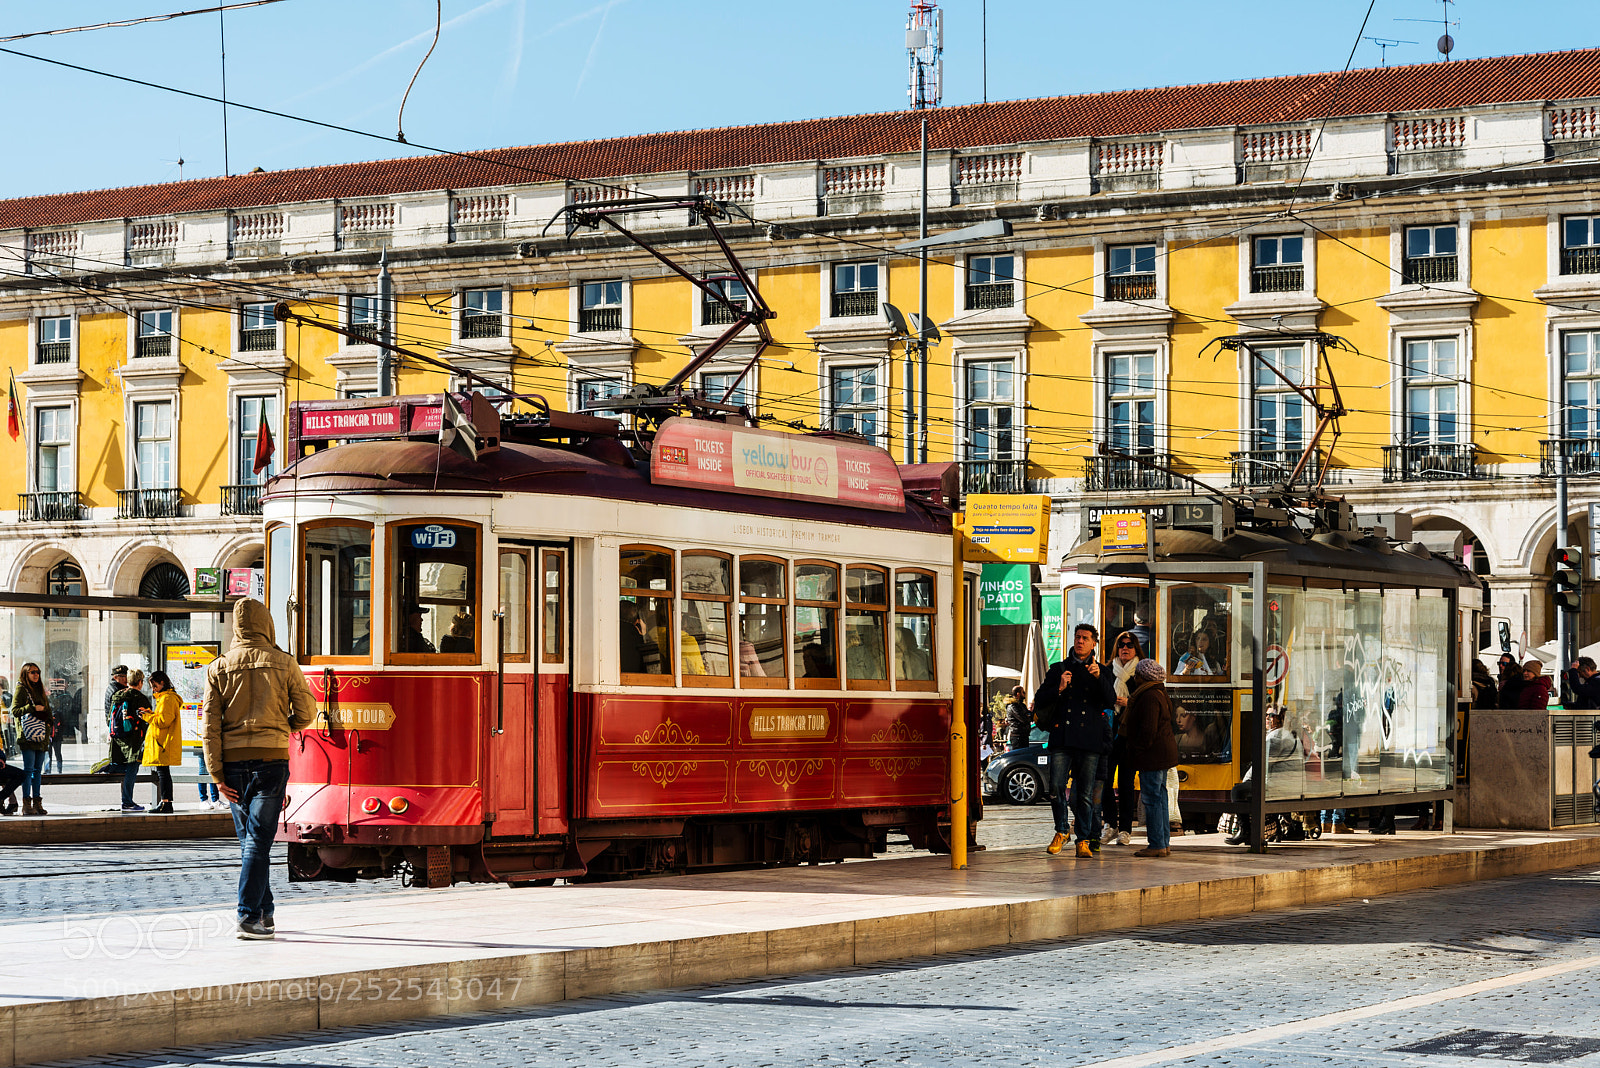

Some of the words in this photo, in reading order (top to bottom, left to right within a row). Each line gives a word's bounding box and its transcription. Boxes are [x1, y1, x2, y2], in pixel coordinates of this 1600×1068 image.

[306, 415, 331, 429] HILLS
[333, 413, 370, 428] TRAMCAR
[371, 412, 394, 426] TOUR
[694, 438, 724, 454] TICKETS
[698, 457, 722, 472] INSIDE
[845, 459, 871, 474] TICKETS
[745, 469, 766, 479] OFFICIAL
[767, 471, 796, 483] SIGHTSEEING
[797, 475, 812, 485] TOURS
[847, 476, 869, 490] INSIDE
[1184, 505, 1204, 520] 15
[733, 524, 753, 535] LISBON
[757, 527, 788, 539] HISTORICAL
[792, 530, 815, 541] PREMIUM
[818, 532, 840, 543] TRAMCAR
[980, 580, 1023, 591] VINHOS
[987, 591, 1024, 604] PÁTIO
[356, 708, 386, 724] TOUR
[754, 715, 775, 732] HILLS
[777, 715, 806, 731] TRAMCAR
[807, 714, 825, 731] TOUR
